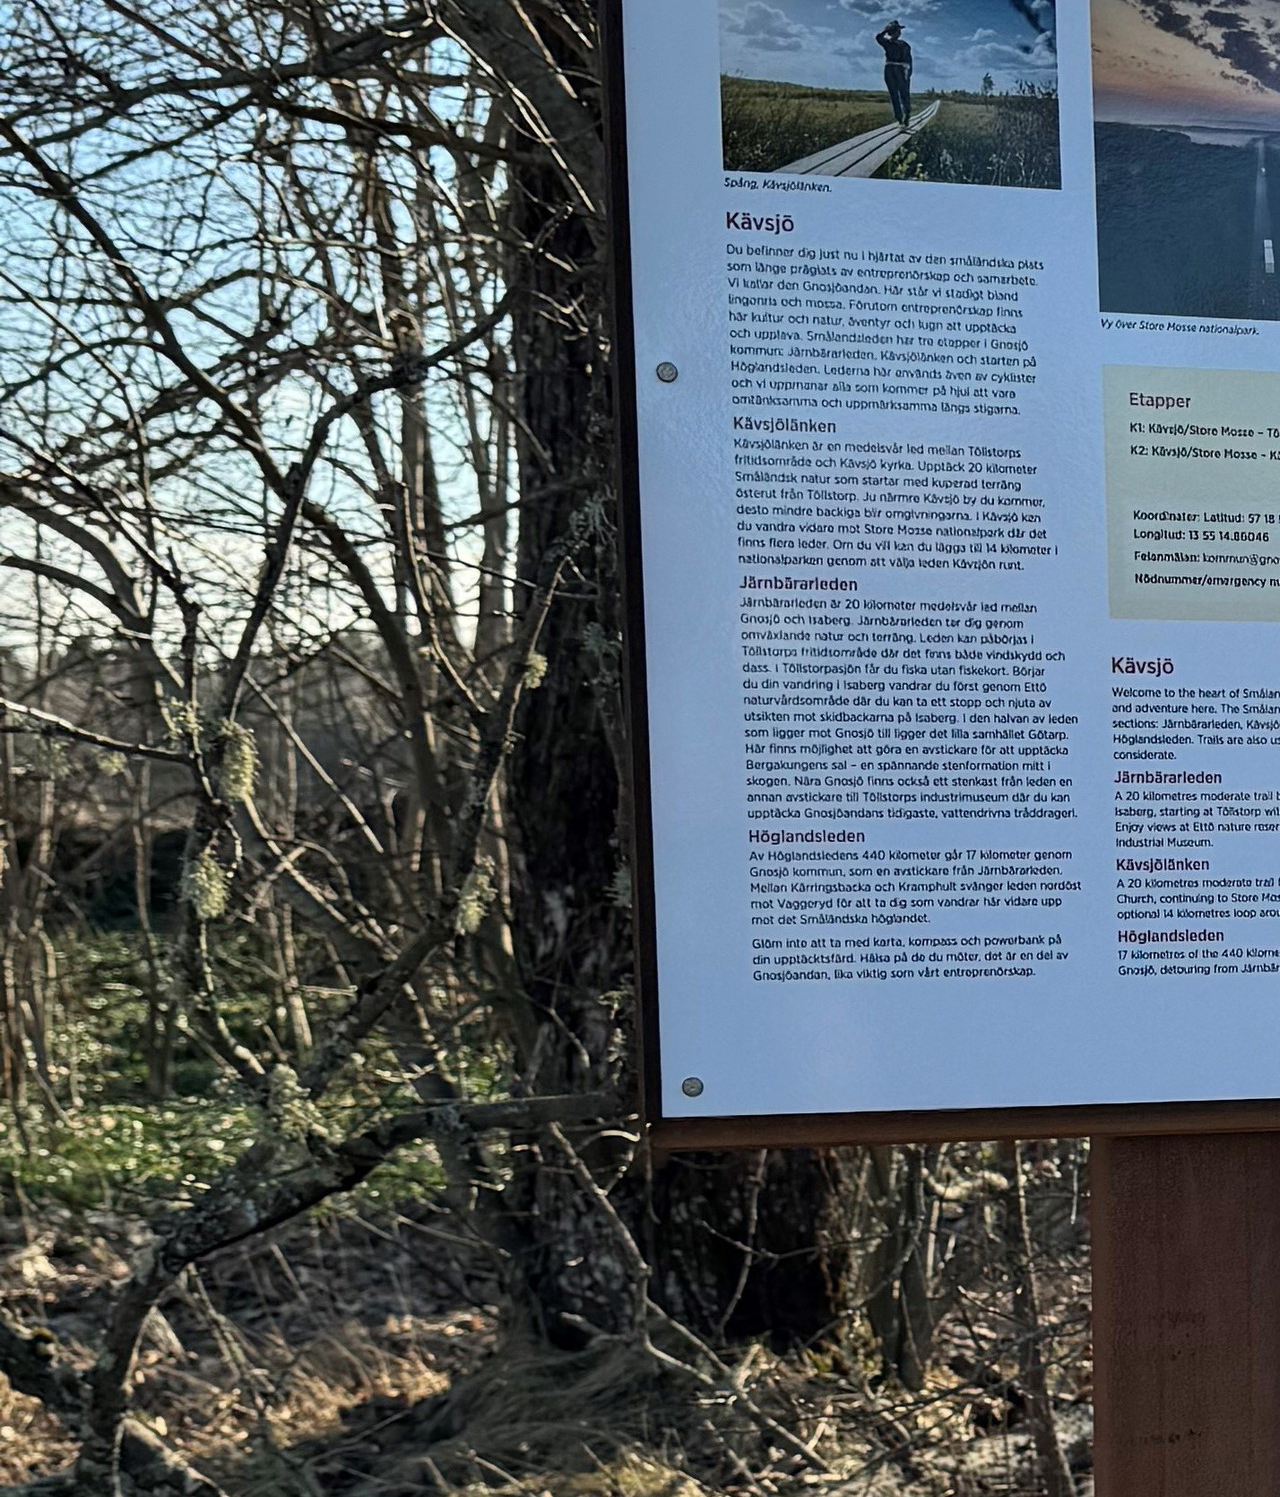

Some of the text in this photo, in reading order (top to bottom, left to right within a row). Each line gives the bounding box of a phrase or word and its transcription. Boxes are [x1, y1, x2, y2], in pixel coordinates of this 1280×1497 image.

[725, 210, 796, 236] Kävsjö
[1099, 317, 1115, 331] Vy
[1113, 318, 1138, 330] över
[1165, 320, 1198, 334] Mosse
[1128, 390, 1192, 411] Etapper
[732, 414, 837, 434] Kävsjölänken
[1128, 421, 1146, 434] K1:
[1147, 421, 1219, 437] Kävsjö/Store
[1219, 424, 1256, 438] Mosse
[1129, 443, 1149, 457] K2:
[1150, 444, 1222, 460] Kävsjö/Store
[1222, 447, 1258, 461] Mosse
[1202, 510, 1246, 524] Latitud:
[1246, 512, 1262, 525] 57
[1201, 529, 1217, 542] 55
[738, 574, 859, 592] Järnbärarleden
[781, 661, 863, 676] Töllstorpasjön
[863, 661, 881, 675] får
[882, 662, 899, 676] du
[900, 662, 928, 676] fiska
[929, 664, 957, 677] utan
[957, 663, 1011, 677] fiskekort.
[1011, 664, 1046, 679] Börjar
[1110, 655, 1175, 678] Kävsjö
[1110, 685, 1163, 699] Welcome
[1176, 686, 1197, 699] the
[1197, 686, 1227, 699] heart
[1110, 701, 1133, 714] and
[1133, 701, 1190, 714] adventure
[1190, 702, 1218, 715] here.
[1219, 702, 1241, 715] The
[742, 709, 791, 723] utsikten
[792, 711, 817, 723] mot
[818, 710, 896, 723] skidbackarna
[896, 710, 913, 725] på
[914, 711, 960, 726] Isaberg.
[968, 711, 992, 724] den
[992, 712, 1030, 725] halvan
[1031, 714, 1046, 725] av
[1047, 712, 1079, 725] leden
[743, 725, 1070, 742] som ligger mot Gnosjö till ligger det lilla samhället Götarp.
[1112, 769, 1223, 785] Järnbärarleden
[1124, 789, 1141, 802] 20
[1141, 789, 1199, 802] kilometres
[1199, 790, 1252, 802] moderate
[747, 828, 866, 846] Höglandsleden
[1114, 856, 1211, 874] Kävsjölänken
[1116, 927, 1225, 946] Höglandsleden
